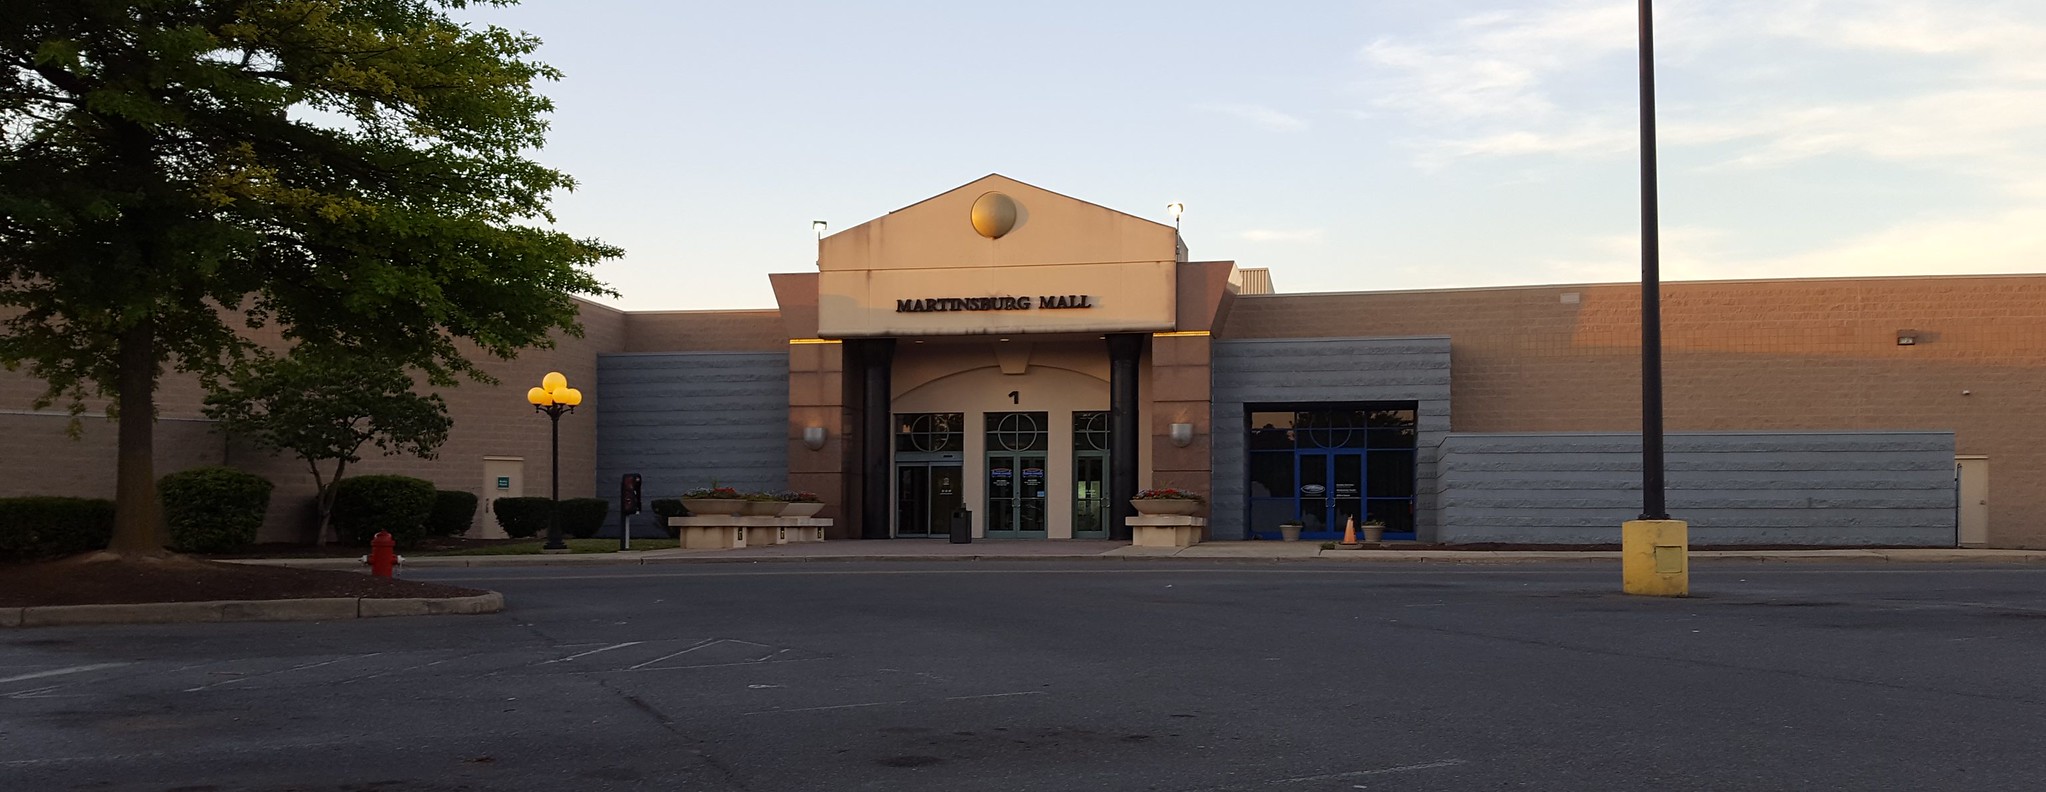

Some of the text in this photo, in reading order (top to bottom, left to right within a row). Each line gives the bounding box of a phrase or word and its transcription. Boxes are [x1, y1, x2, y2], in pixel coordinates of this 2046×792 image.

[896, 295, 1091, 313] MARTINSBURG MALL
[1008, 390, 1019, 405] 1
